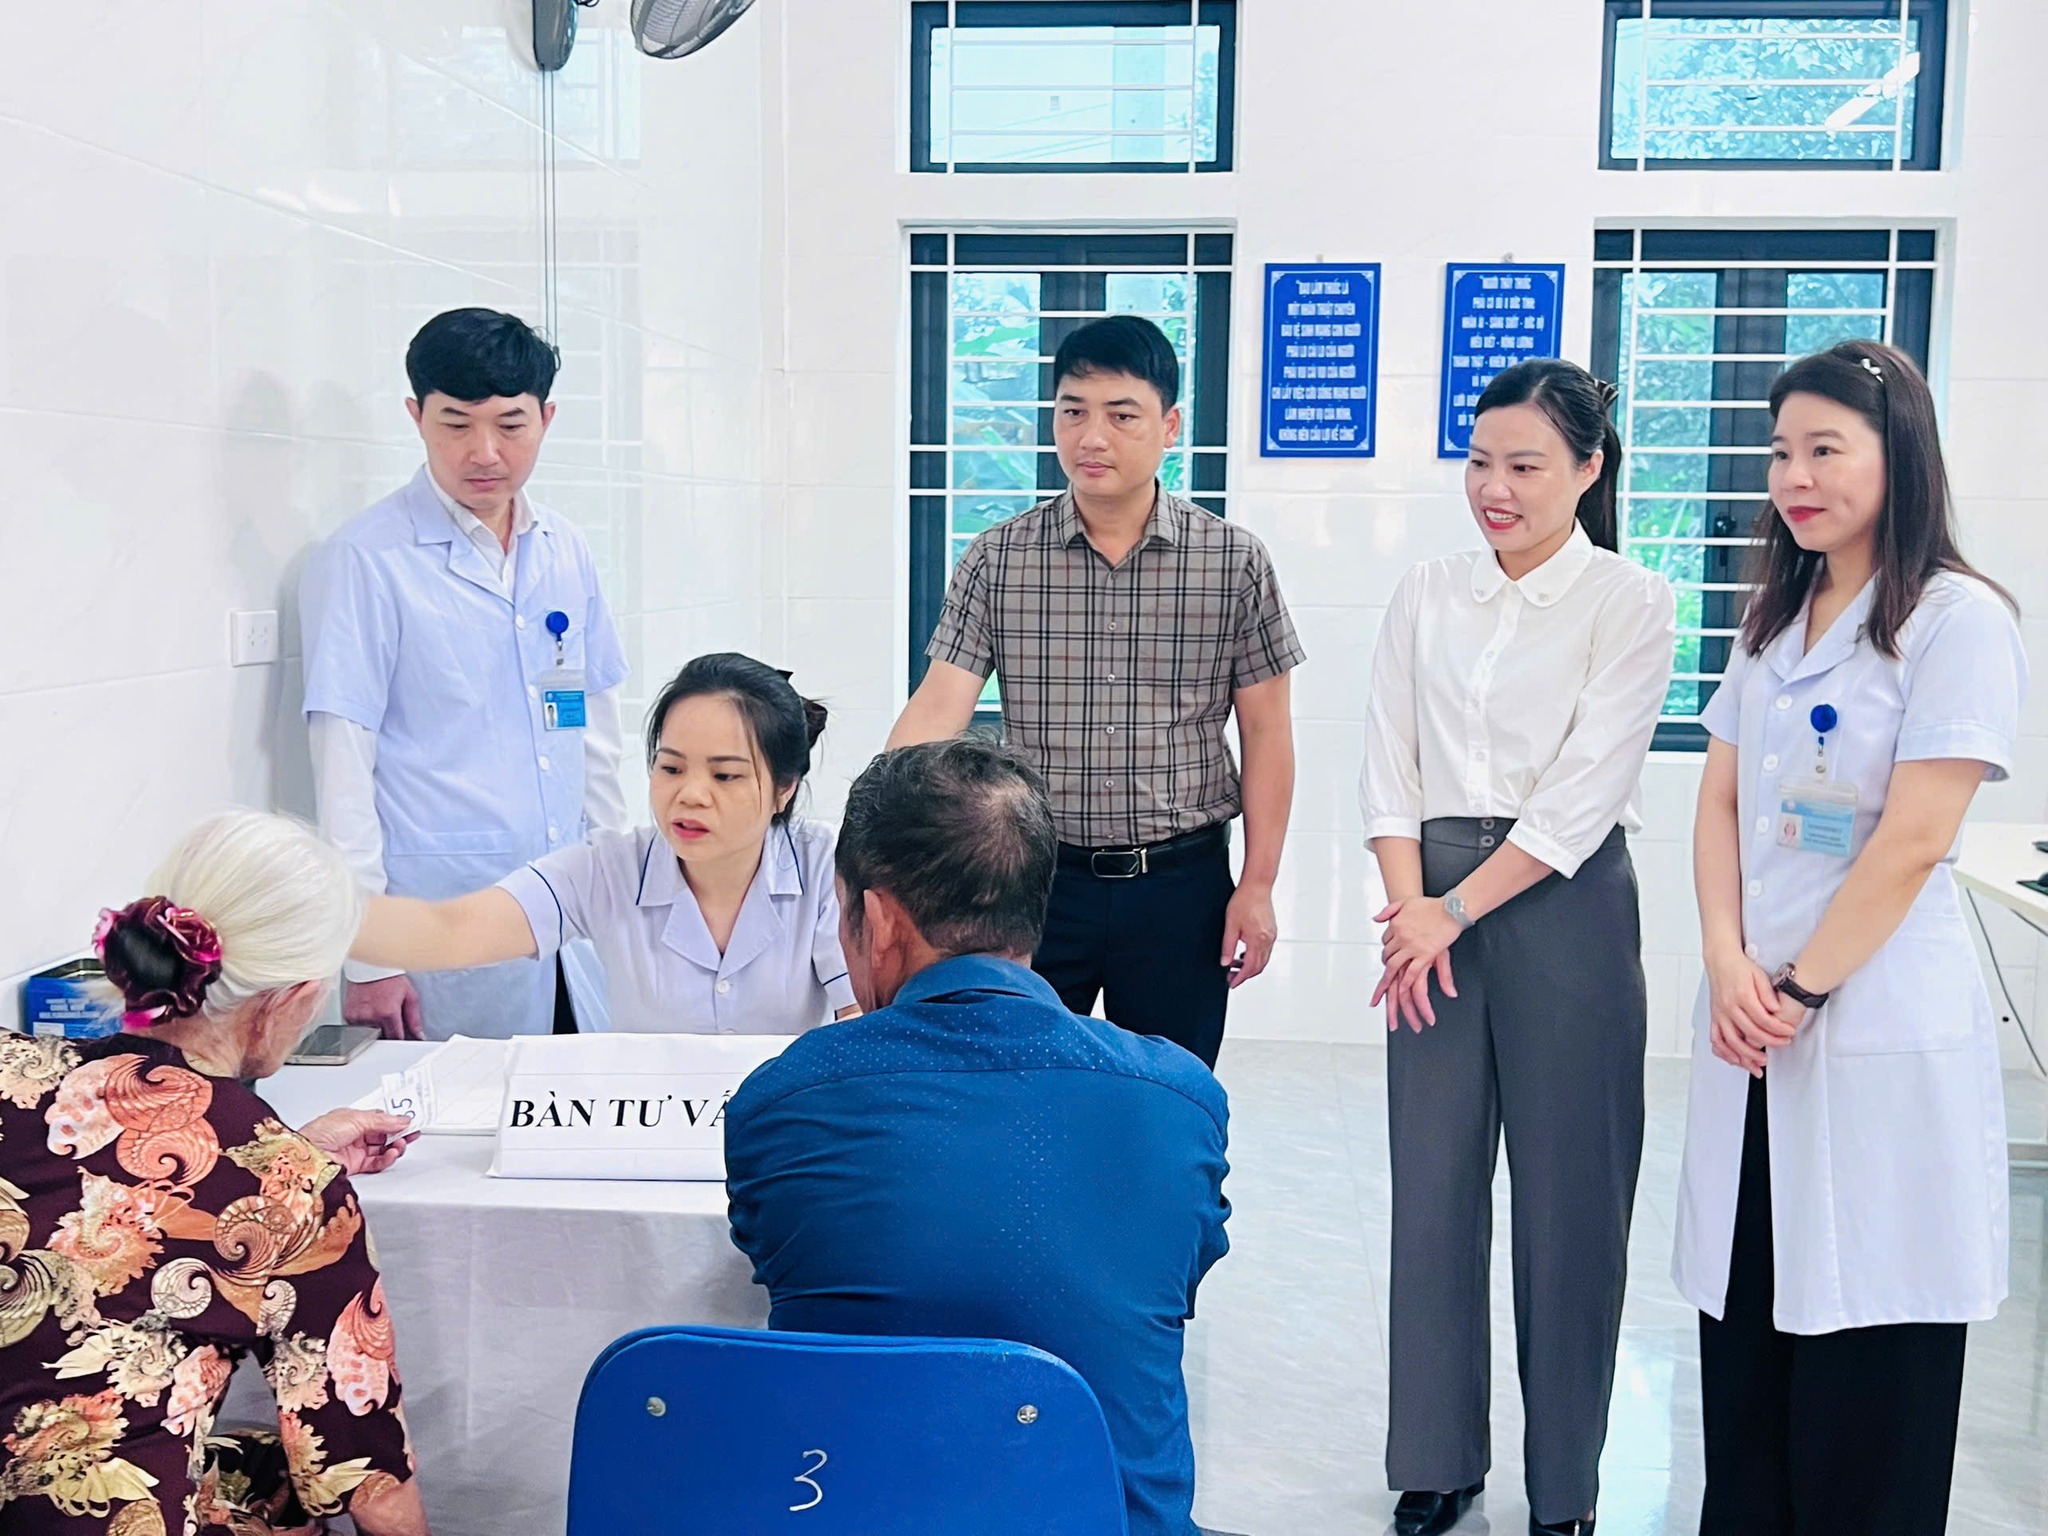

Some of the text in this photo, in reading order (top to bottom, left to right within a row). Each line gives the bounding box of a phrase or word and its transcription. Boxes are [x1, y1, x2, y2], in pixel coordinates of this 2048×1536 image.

[509, 1091, 596, 1127] BÀN
[609, 1094, 673, 1127] TƯ
[789, 1449, 828, 1512] 3
